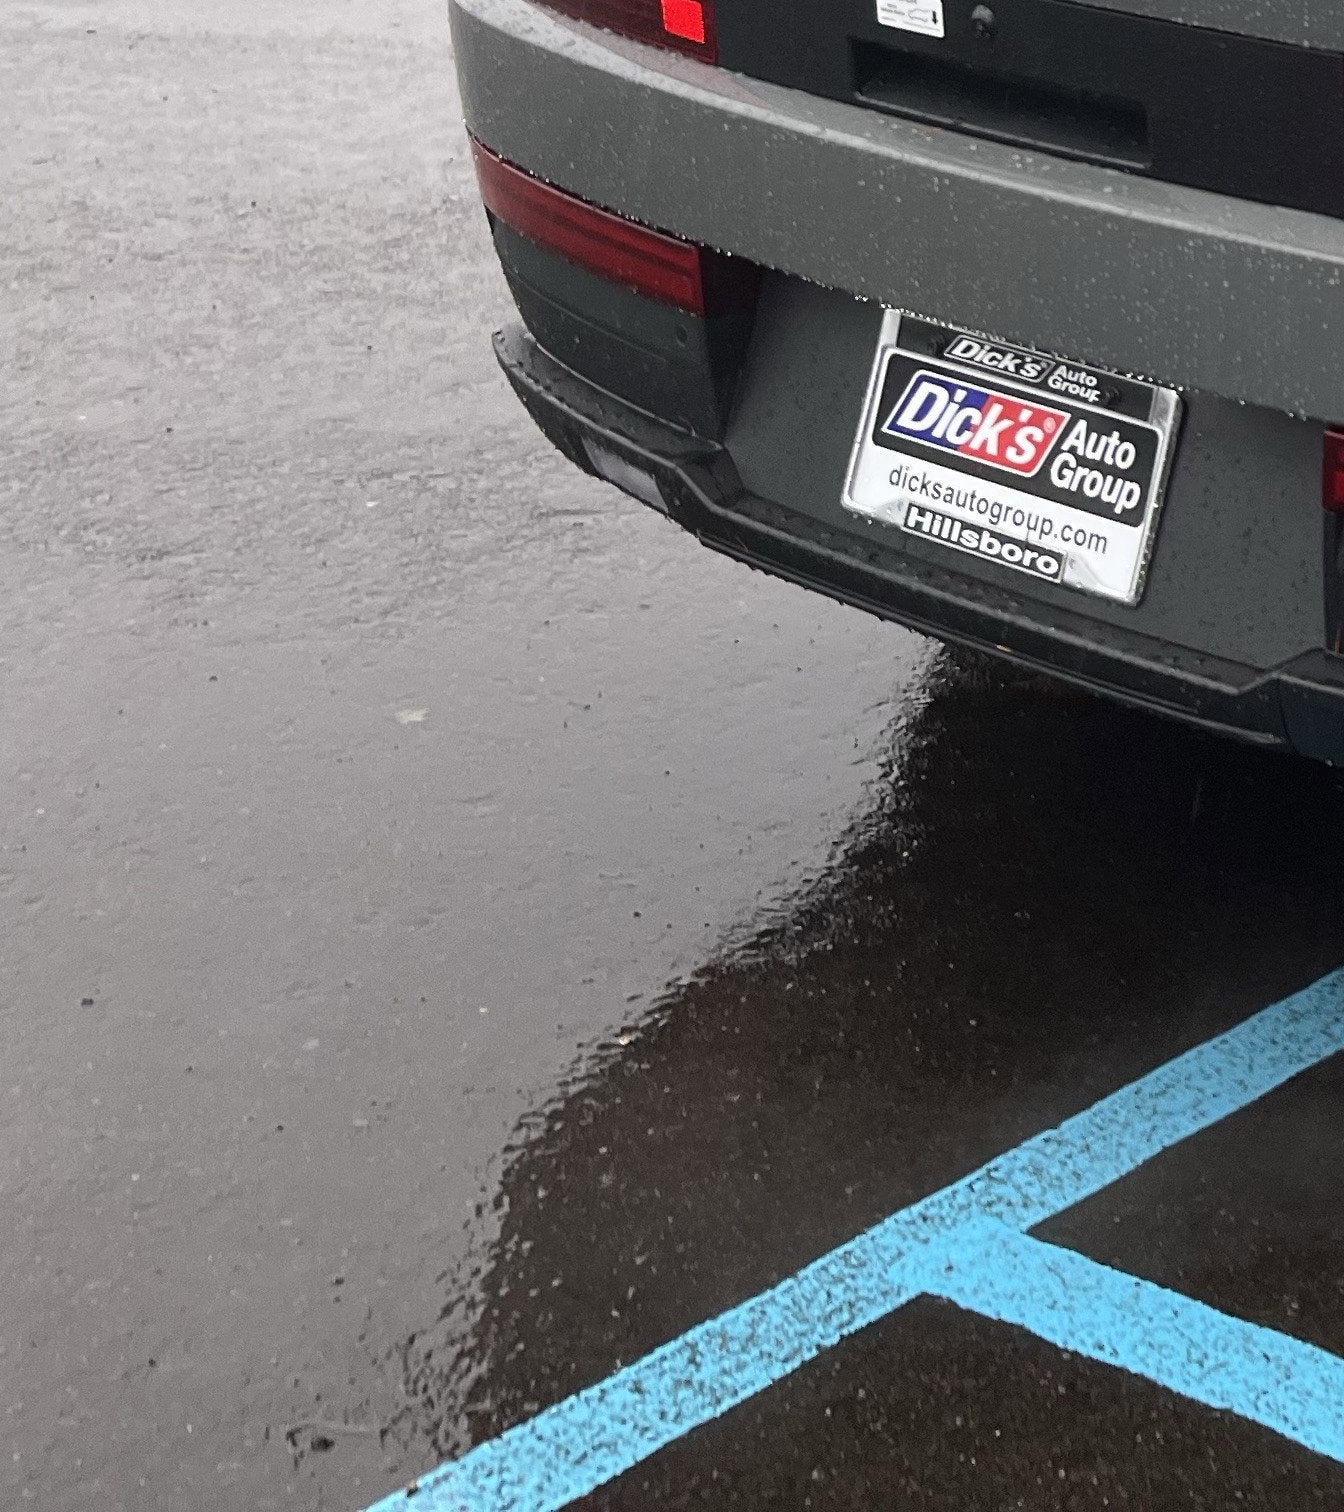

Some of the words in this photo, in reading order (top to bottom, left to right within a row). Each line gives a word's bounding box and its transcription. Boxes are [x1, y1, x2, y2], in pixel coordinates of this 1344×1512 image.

[951, 338, 1042, 379] Dick's
[1053, 364, 1098, 387] Auto
[895, 381, 1045, 466] Dick's
[1061, 419, 1136, 470] Auto
[889, 465, 1108, 554] dicksautogroup.com
[1050, 452, 1142, 514] Group
[905, 506, 1060, 575] Hillsboro
